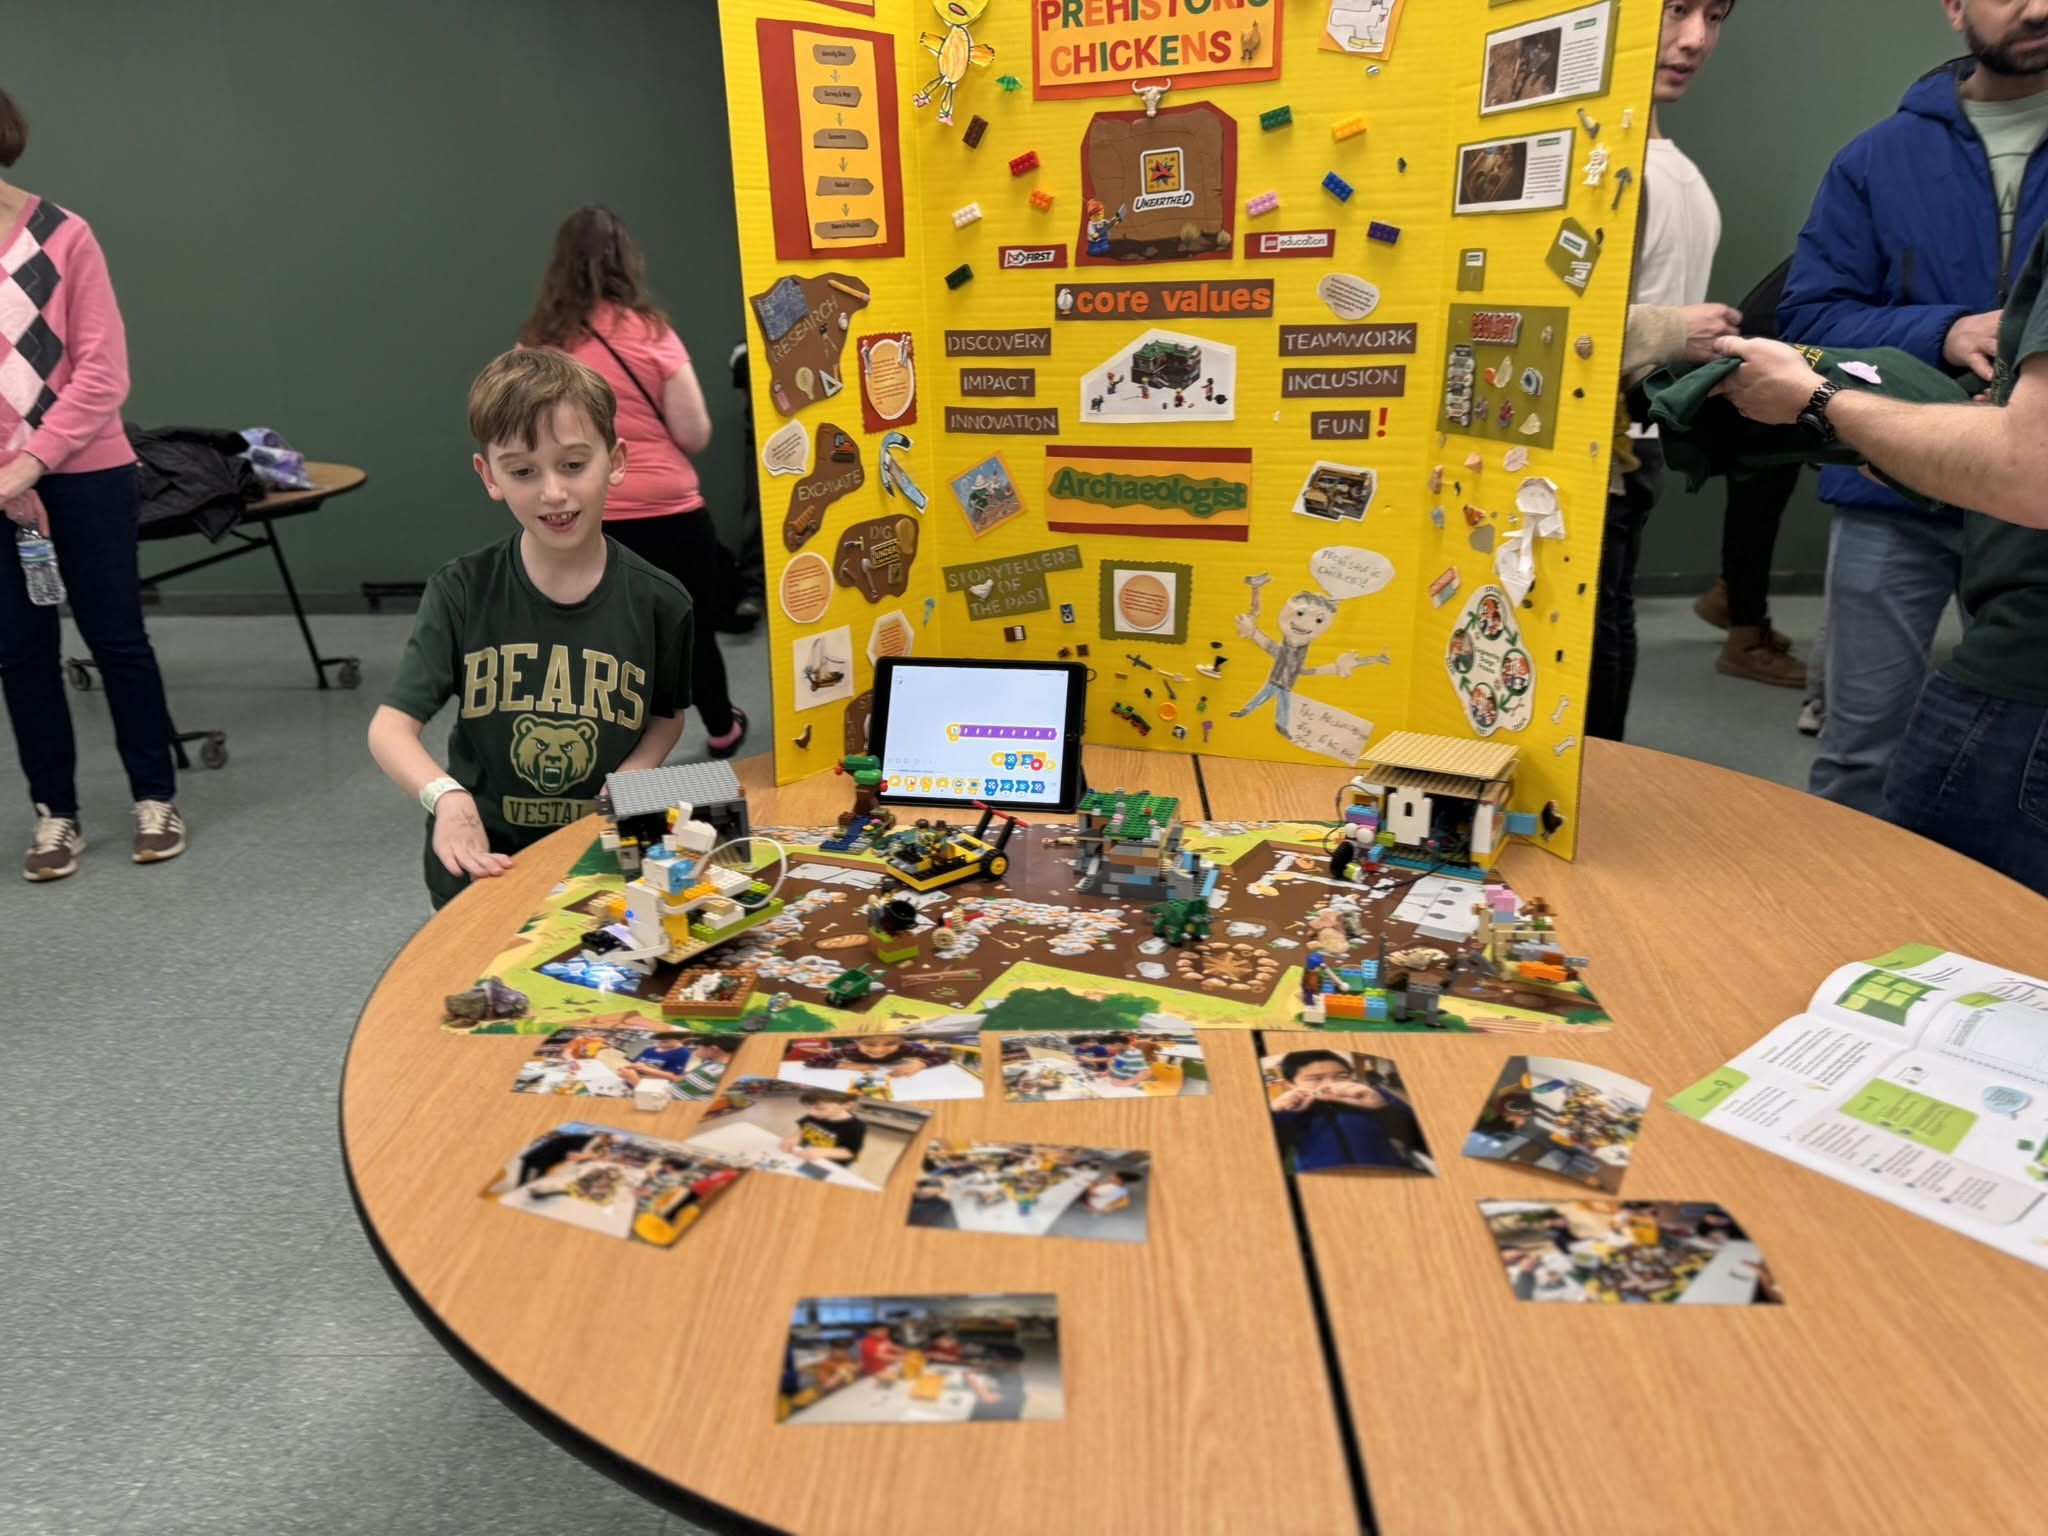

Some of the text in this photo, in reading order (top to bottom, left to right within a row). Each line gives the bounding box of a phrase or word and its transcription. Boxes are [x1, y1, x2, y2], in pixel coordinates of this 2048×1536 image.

[1041, 0, 1269, 31] PREHIST
[1050, 31, 1232, 77] CHICKENS
[1280, 235, 1325, 247] education
[1025, 251, 1052, 262] FIRST
[1076, 283, 1272, 314] core values
[771, 295, 839, 363] RESEARCH
[1284, 329, 1412, 350] TEAMWORK
[948, 333, 1048, 351] DISCOVERY
[963, 375, 1031, 391] IMPACT
[1288, 368, 1398, 391] INCLUSION
[951, 413, 1056, 431] INNOVATION
[798, 470, 862, 501] EXCAVATE
[1055, 470, 1246, 516] Archaeologist
[870, 525, 892, 539] DIG
[949, 548, 1077, 588] STORYTELLERS
[999, 578, 1021, 594] OF
[970, 588, 1046, 616] THE PAST
[461, 643, 645, 730] BEARS
